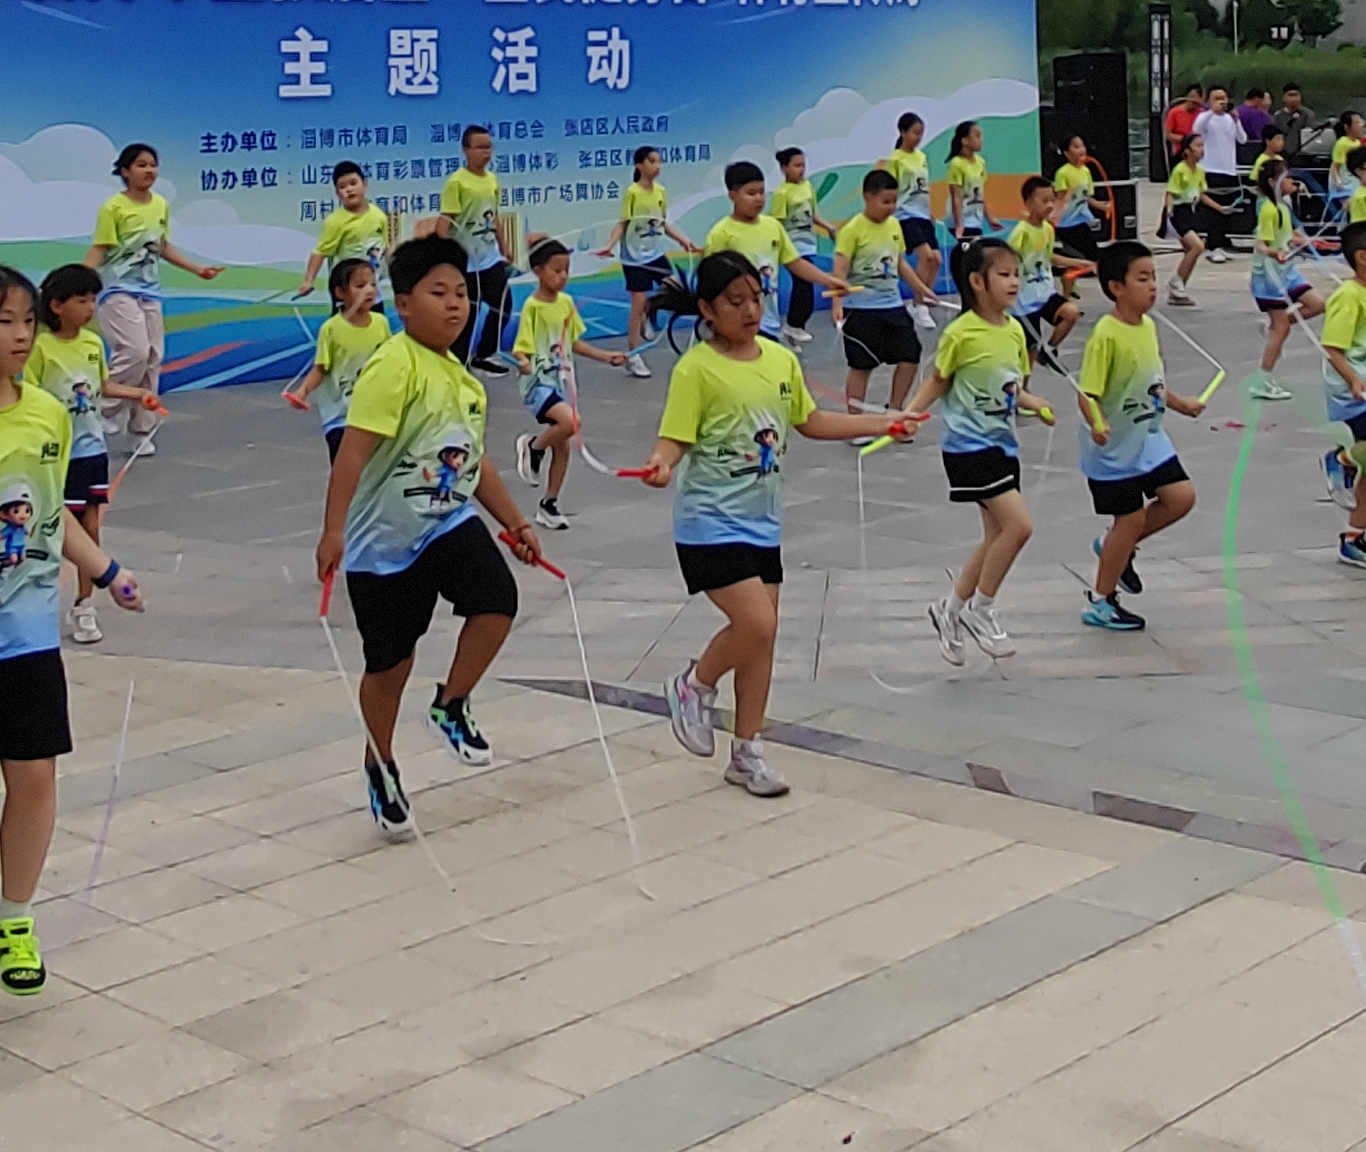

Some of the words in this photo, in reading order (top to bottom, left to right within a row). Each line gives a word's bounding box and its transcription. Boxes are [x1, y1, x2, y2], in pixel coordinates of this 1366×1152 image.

[430, 119, 544, 143] 淄博体育总会
[564, 114, 670, 138] 张店区人民政府
